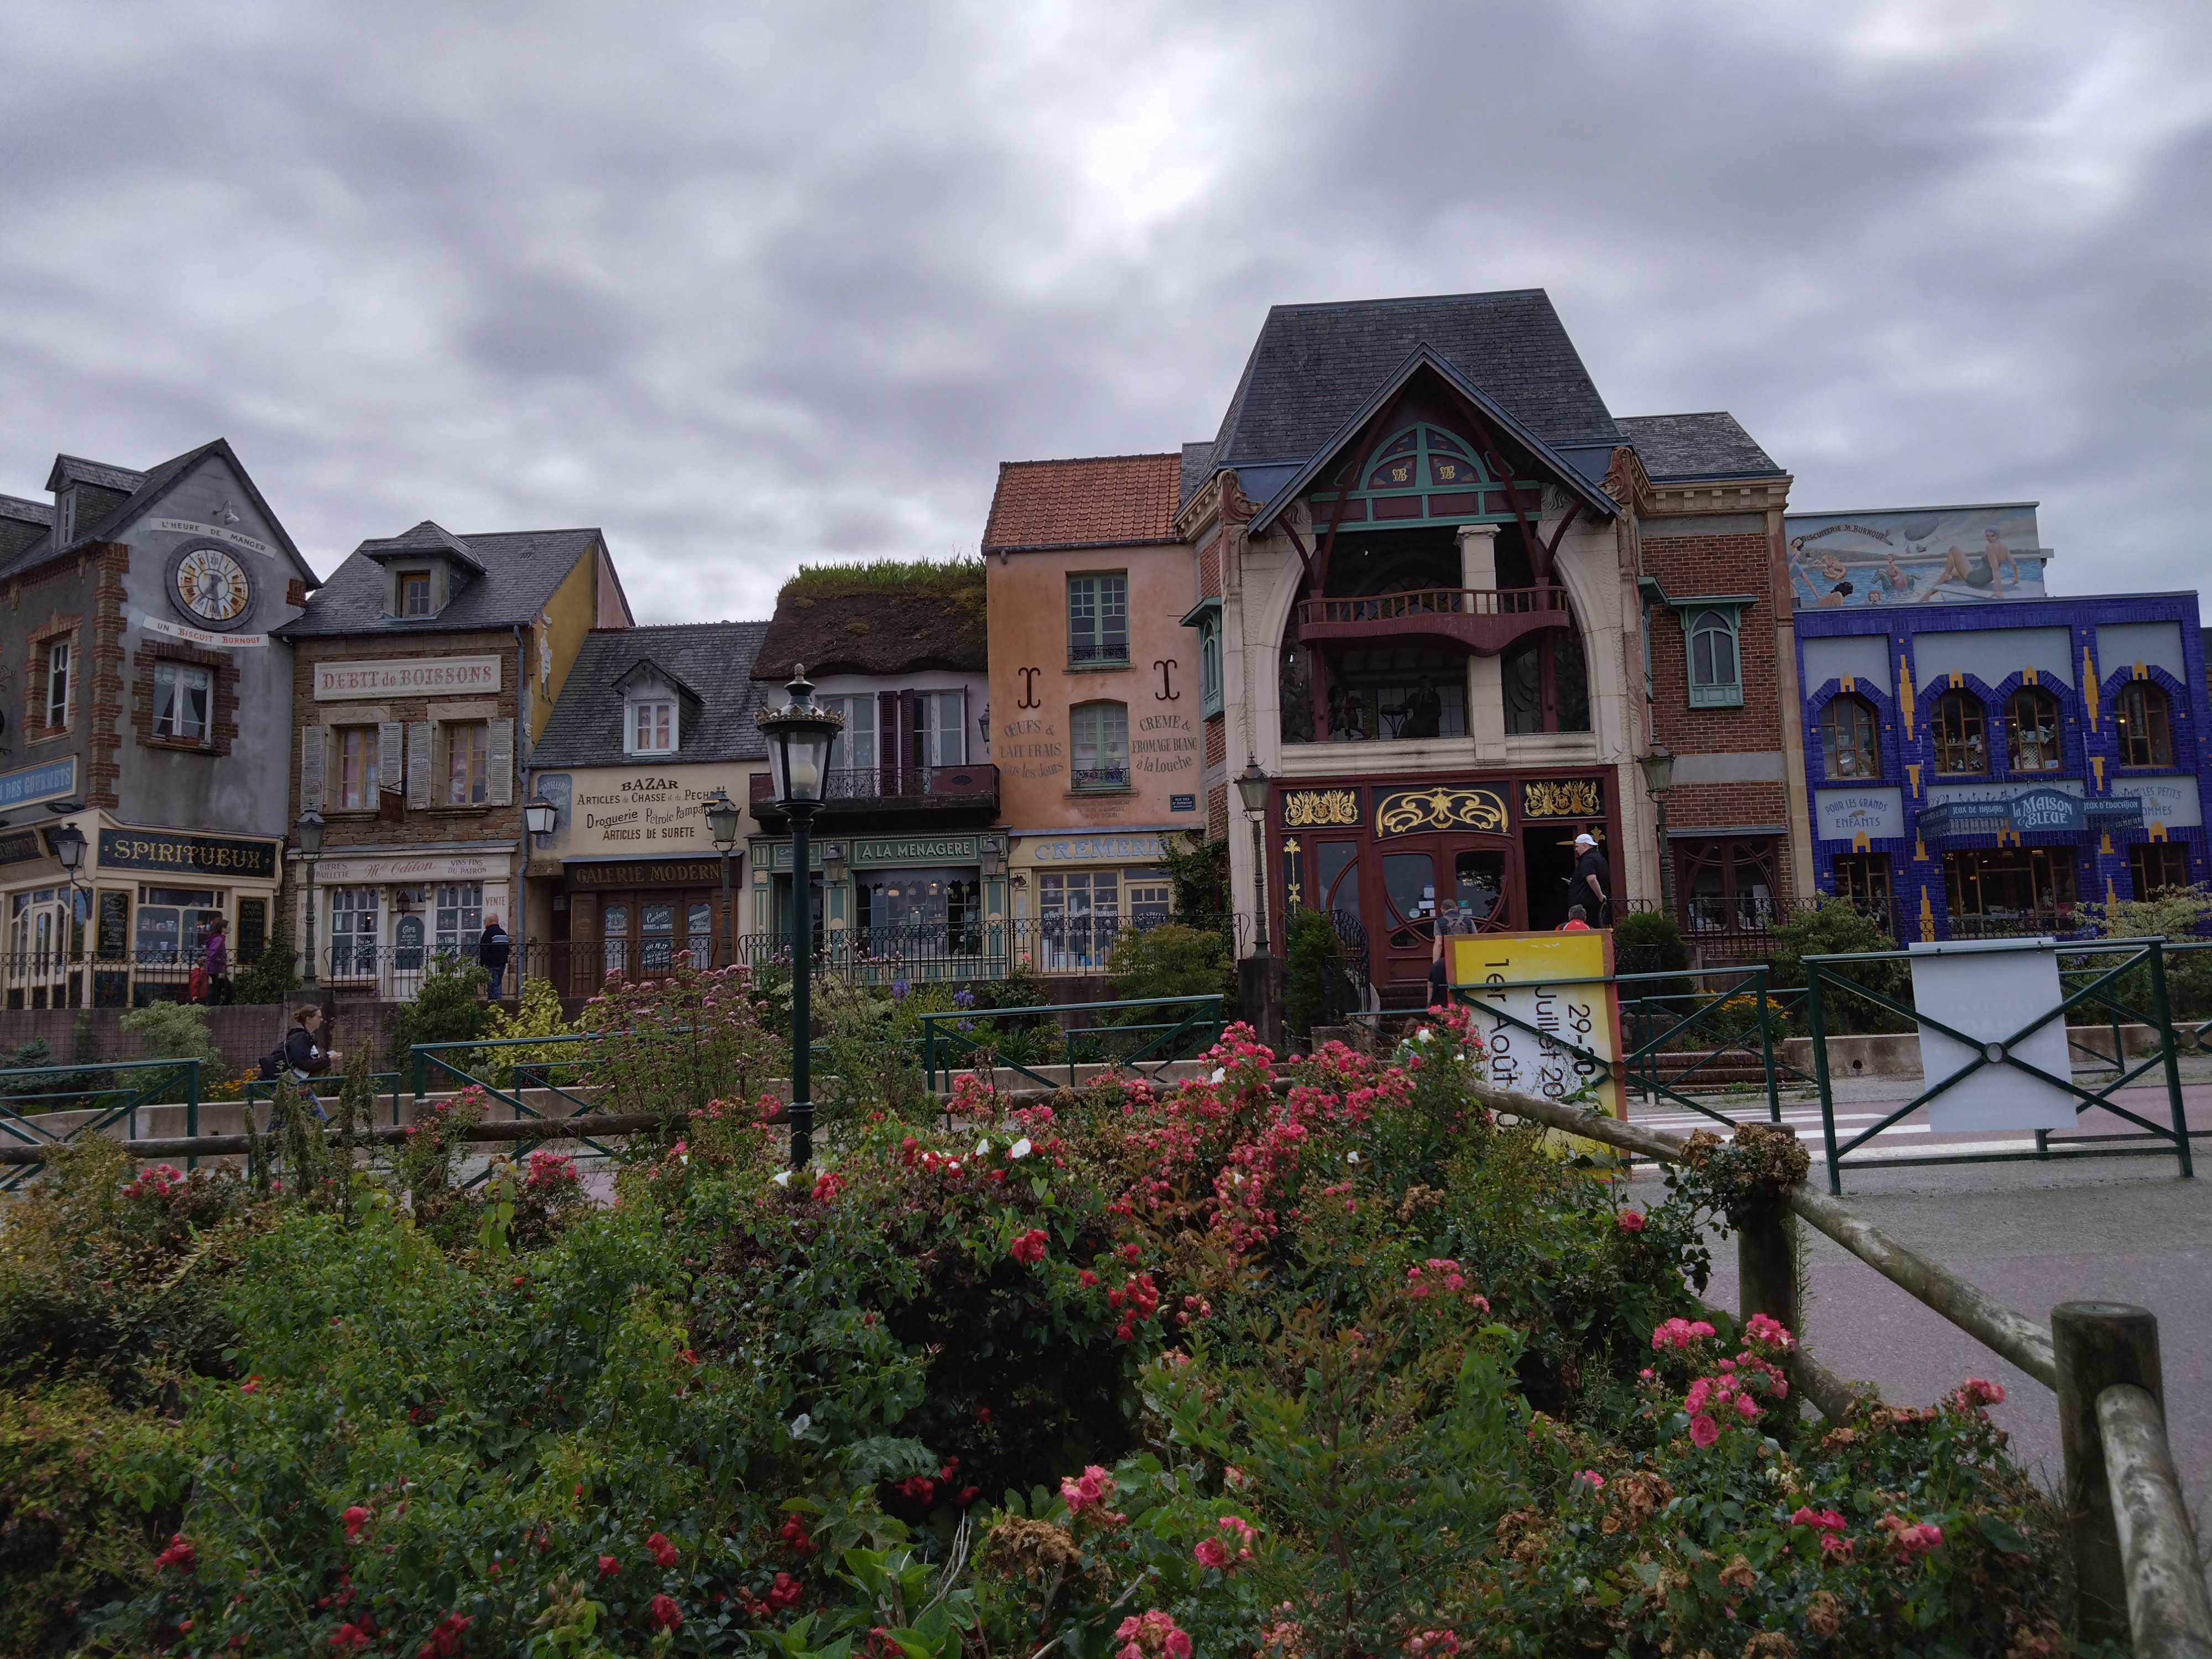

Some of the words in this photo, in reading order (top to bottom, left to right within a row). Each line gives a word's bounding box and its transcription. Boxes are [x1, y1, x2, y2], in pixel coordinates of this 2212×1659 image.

[162, 521, 200, 531] L'HEURE
[230, 534, 266, 551] MANGER
[1802, 525, 1841, 542] BISCUITERIE
[158, 623, 169, 632] UN
[178, 628, 213, 643] BISCUIT
[322, 671, 379, 690] DEBIT
[382, 672, 395, 687] de
[400, 665, 492, 686] BOISSONS
[1045, 724, 1055, 736] &
[1139, 715, 1181, 732] CREME
[1181, 720, 1191, 732] &
[1000, 744, 1024, 759] LAIT
[1028, 742, 1062, 757] FRAIS
[1132, 738, 1171, 753] FROMAGE
[1172, 737, 1197, 752] BLANC
[1022, 763, 1036, 778] les
[1038, 761, 1064, 778] Jours
[1145, 757, 1153, 772] la
[1155, 755, 1192, 773] Louche
[6, 780, 22, 799] DES
[622, 778, 679, 791] BAZAR
[2142, 786, 2154, 796] LES
[2158, 786, 2182, 800] PETITS
[1824, 801, 1844, 815] POUR
[1845, 799, 1857, 808] LES
[1859, 799, 1888, 812] GRANDS
[1953, 807, 1967, 815] JEUX
[1979, 805, 2004, 815] HASARD
[2021, 795, 2073, 816] MAISON
[2084, 801, 2098, 811] JEUX
[2142, 806, 2172, 816] OMMES
[587, 810, 638, 828] Droguerie
[646, 807, 674, 825] Pétrole
[1836, 817, 1881, 828] ENFANTS
[2025, 811, 2068, 828] BLEUE
[603, 830, 640, 841] ARTICLES
[647, 828, 656, 838] DE
[662, 827, 695, 838] SURETE
[114, 840, 261, 869] SPIRITUEUX
[862, 844, 872, 859] A
[876, 844, 892, 858] LA
[897, 842, 971, 858] MENAGERE
[316, 870, 349, 879] PAILLETTE
[392, 860, 436, 874] Odilon
[576, 867, 644, 884] GALERIE
[486, 896, 505, 906] VENTE
[647, 910, 669, 924] Carbure
[1485, 958, 1509, 1002] 1er
[1535, 986, 1561, 1060] Juillet
